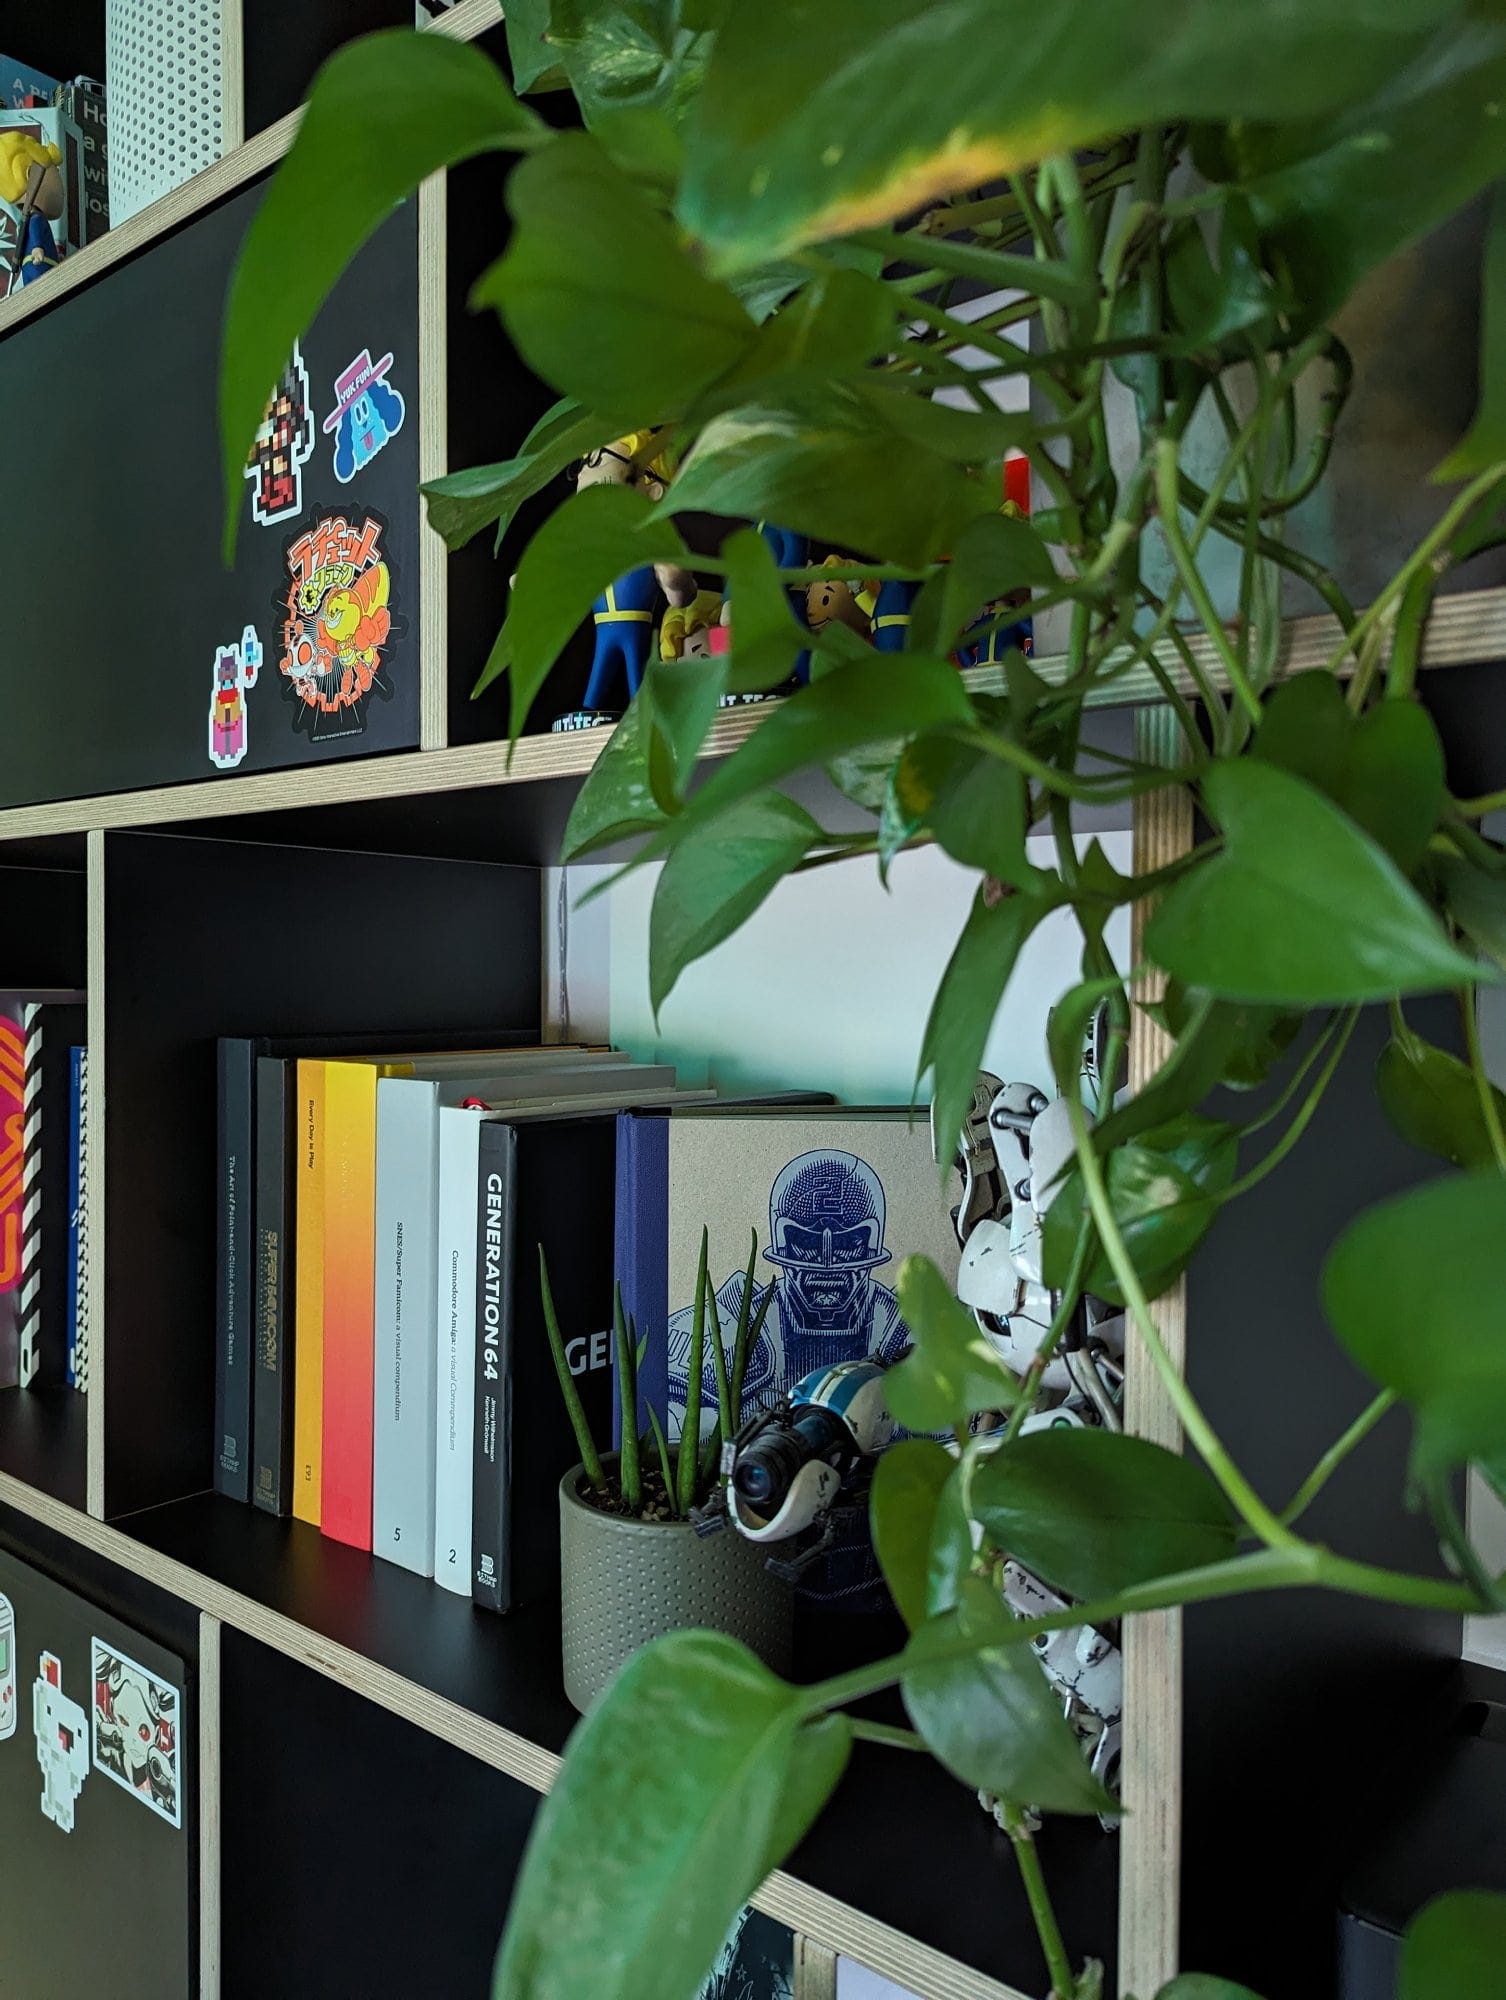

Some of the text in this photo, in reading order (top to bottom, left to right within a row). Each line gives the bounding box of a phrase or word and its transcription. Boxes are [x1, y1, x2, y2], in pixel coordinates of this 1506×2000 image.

[308, 1099, 316, 1123] Every
[308, 1151, 316, 1170] Play
[811, 1176, 844, 1216] 2
[267, 1230, 279, 1283] SUPER
[395, 1221, 405, 1277] SNES/Super
[451, 1249, 460, 1309] Commodore
[483, 1173, 503, 1380] GENERATION 64
[226, 1280, 235, 1331] Adventure
[396, 1278, 405, 1324] Famicom:
[395, 1332, 404, 1360] visual
[449, 1310, 459, 1346] Amiga:
[225, 1333, 234, 1366] Games
[450, 1354, 459, 1382] visual
[393, 1361, 403, 1421] compendium
[394, 1527, 401, 1541] 5
[448, 1548, 457, 1564] 2
